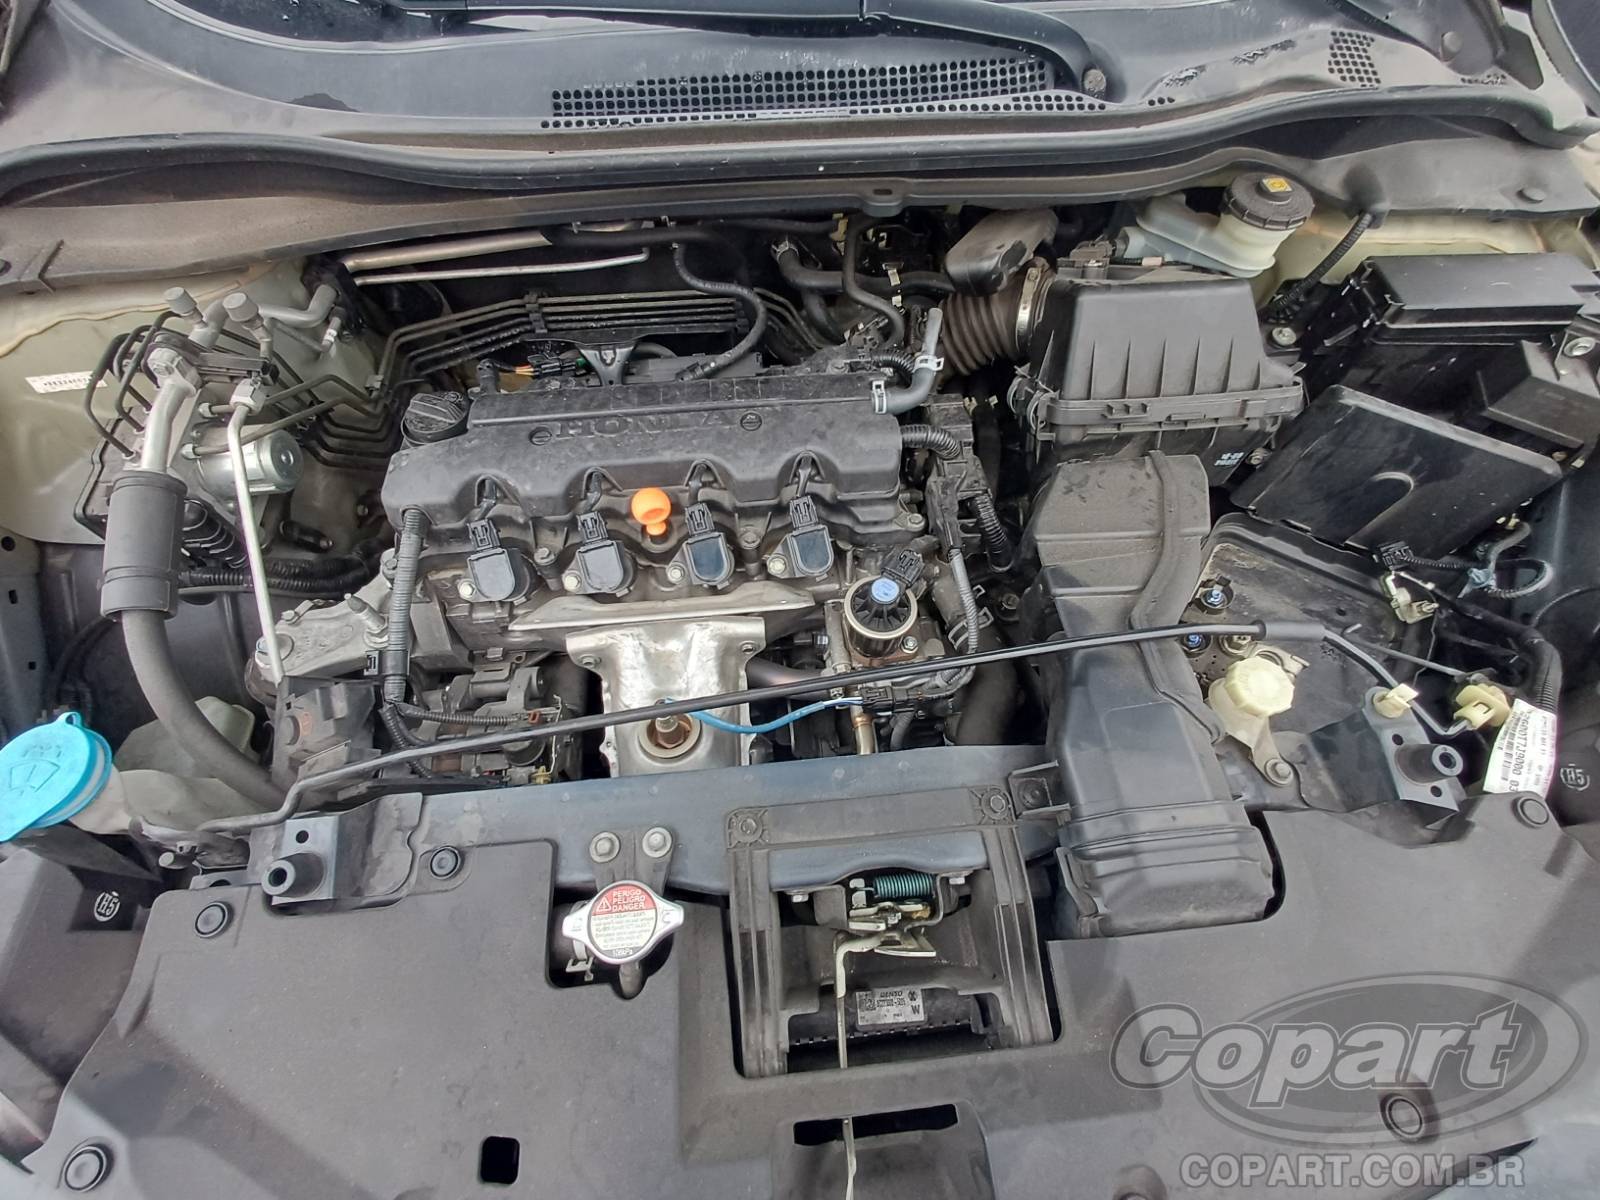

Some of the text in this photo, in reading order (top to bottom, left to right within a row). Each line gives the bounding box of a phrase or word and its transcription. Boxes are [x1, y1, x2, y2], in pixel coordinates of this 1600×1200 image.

[555, 411, 735, 439] HONDA
[612, 889, 641, 898] PERIGO
[612, 895, 646, 904] PELIGRO
[611, 902, 645, 912] DANGER
[880, 990, 903, 998] DENSO
